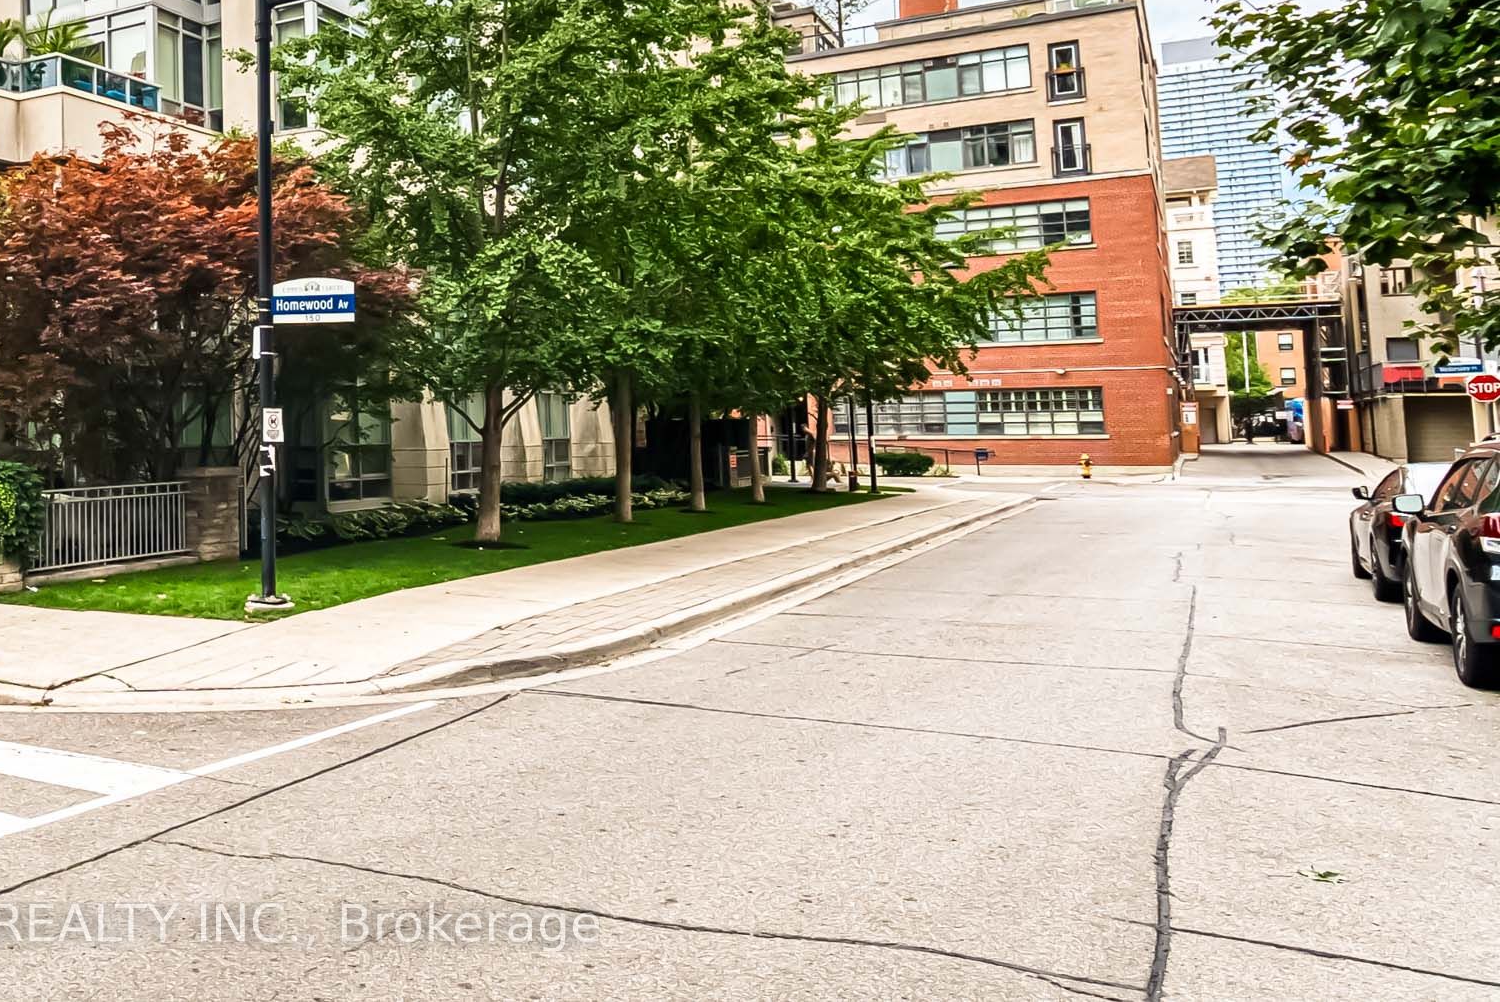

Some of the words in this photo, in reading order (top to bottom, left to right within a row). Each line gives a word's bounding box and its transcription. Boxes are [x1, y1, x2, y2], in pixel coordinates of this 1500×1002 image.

[276, 298, 333, 311] Homewood
[338, 299, 349, 309] Av
[1469, 382, 1500, 394] STOP
